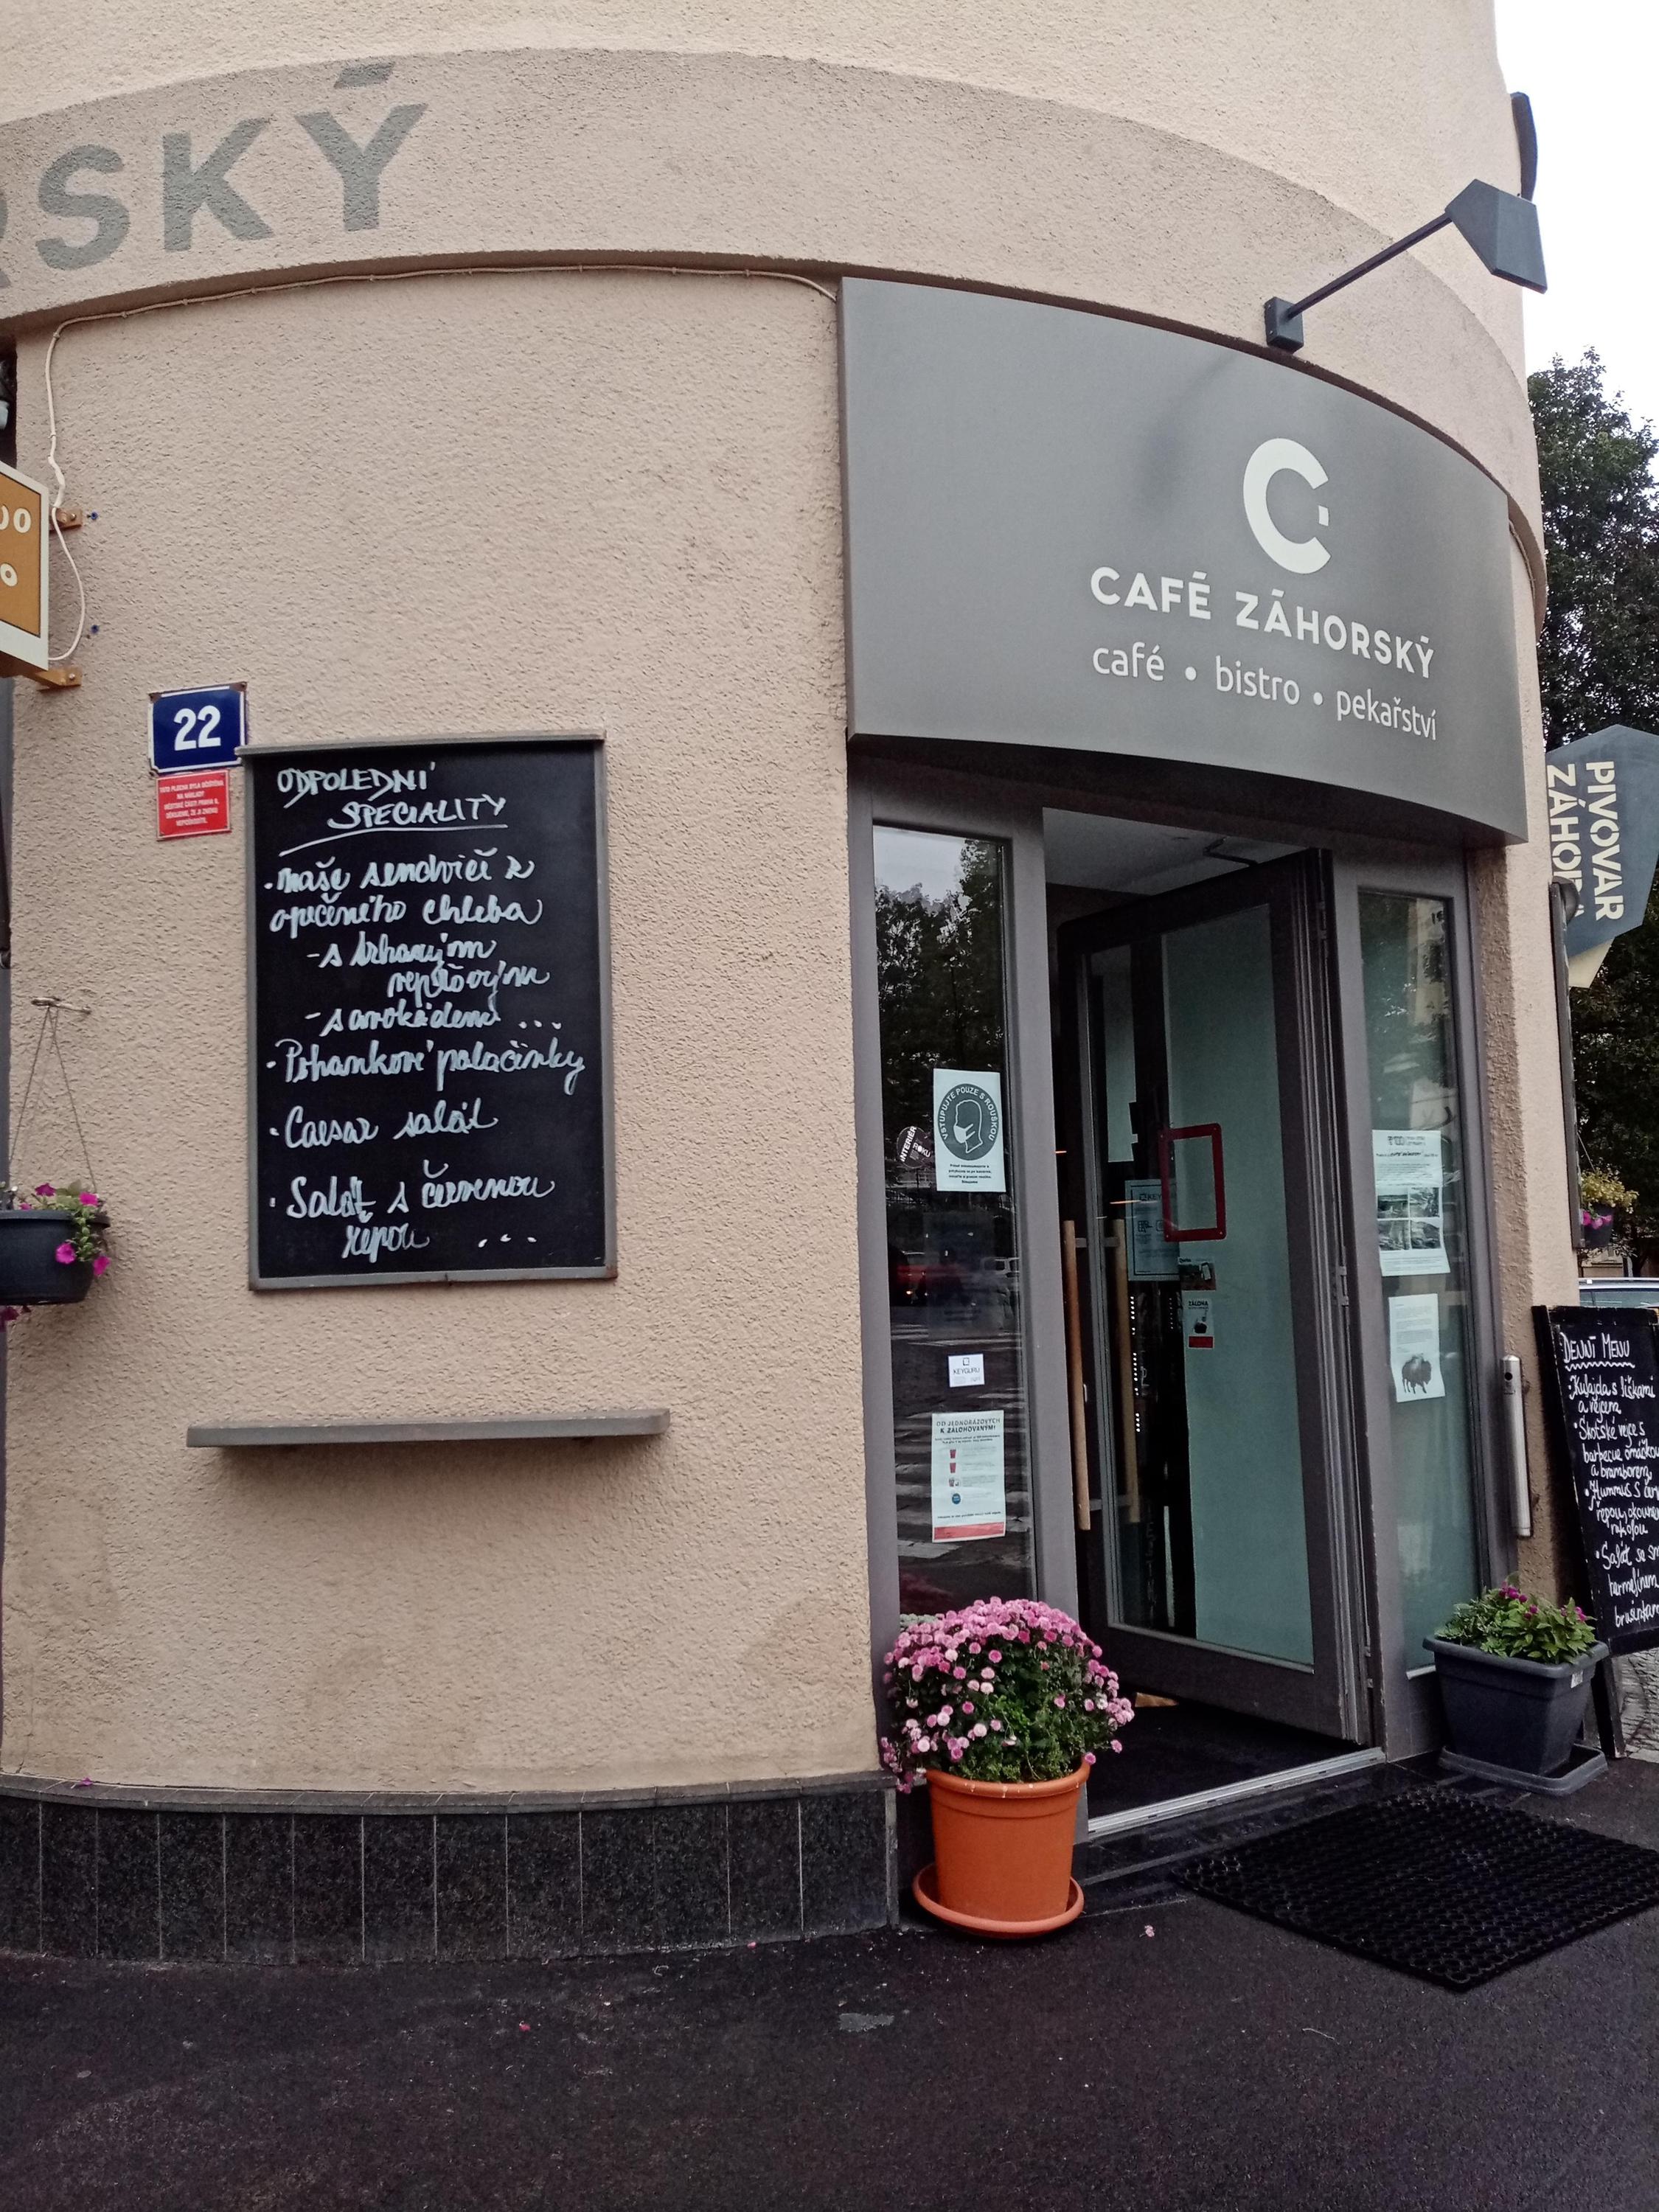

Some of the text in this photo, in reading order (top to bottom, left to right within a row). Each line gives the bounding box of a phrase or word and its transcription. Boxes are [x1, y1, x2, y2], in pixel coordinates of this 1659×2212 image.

[0, 62, 428, 289] SKÝ
[1091, 566, 1434, 679] CAFÉ ZÁHORSKÝ
[1092, 641, 1437, 741] café bistro pekařství
[173, 706, 221, 751] 22
[277, 761, 436, 809] ODPOLEDNÍ
[327, 794, 507, 830] SPECIALITY
[1586, 761, 1624, 921] PIVOVAR
[422, 894, 543, 925] chleba
[285, 1106, 378, 1149] Caesar
[939, 1092, 956, 1140] VSTUPUJTE
[956, 1087, 979, 1096] POUZE
[984, 1099, 998, 1141] ROUŠKOU
[1601, 1332, 1630, 1359] MENU
[1578, 1400, 1588, 1413] a
